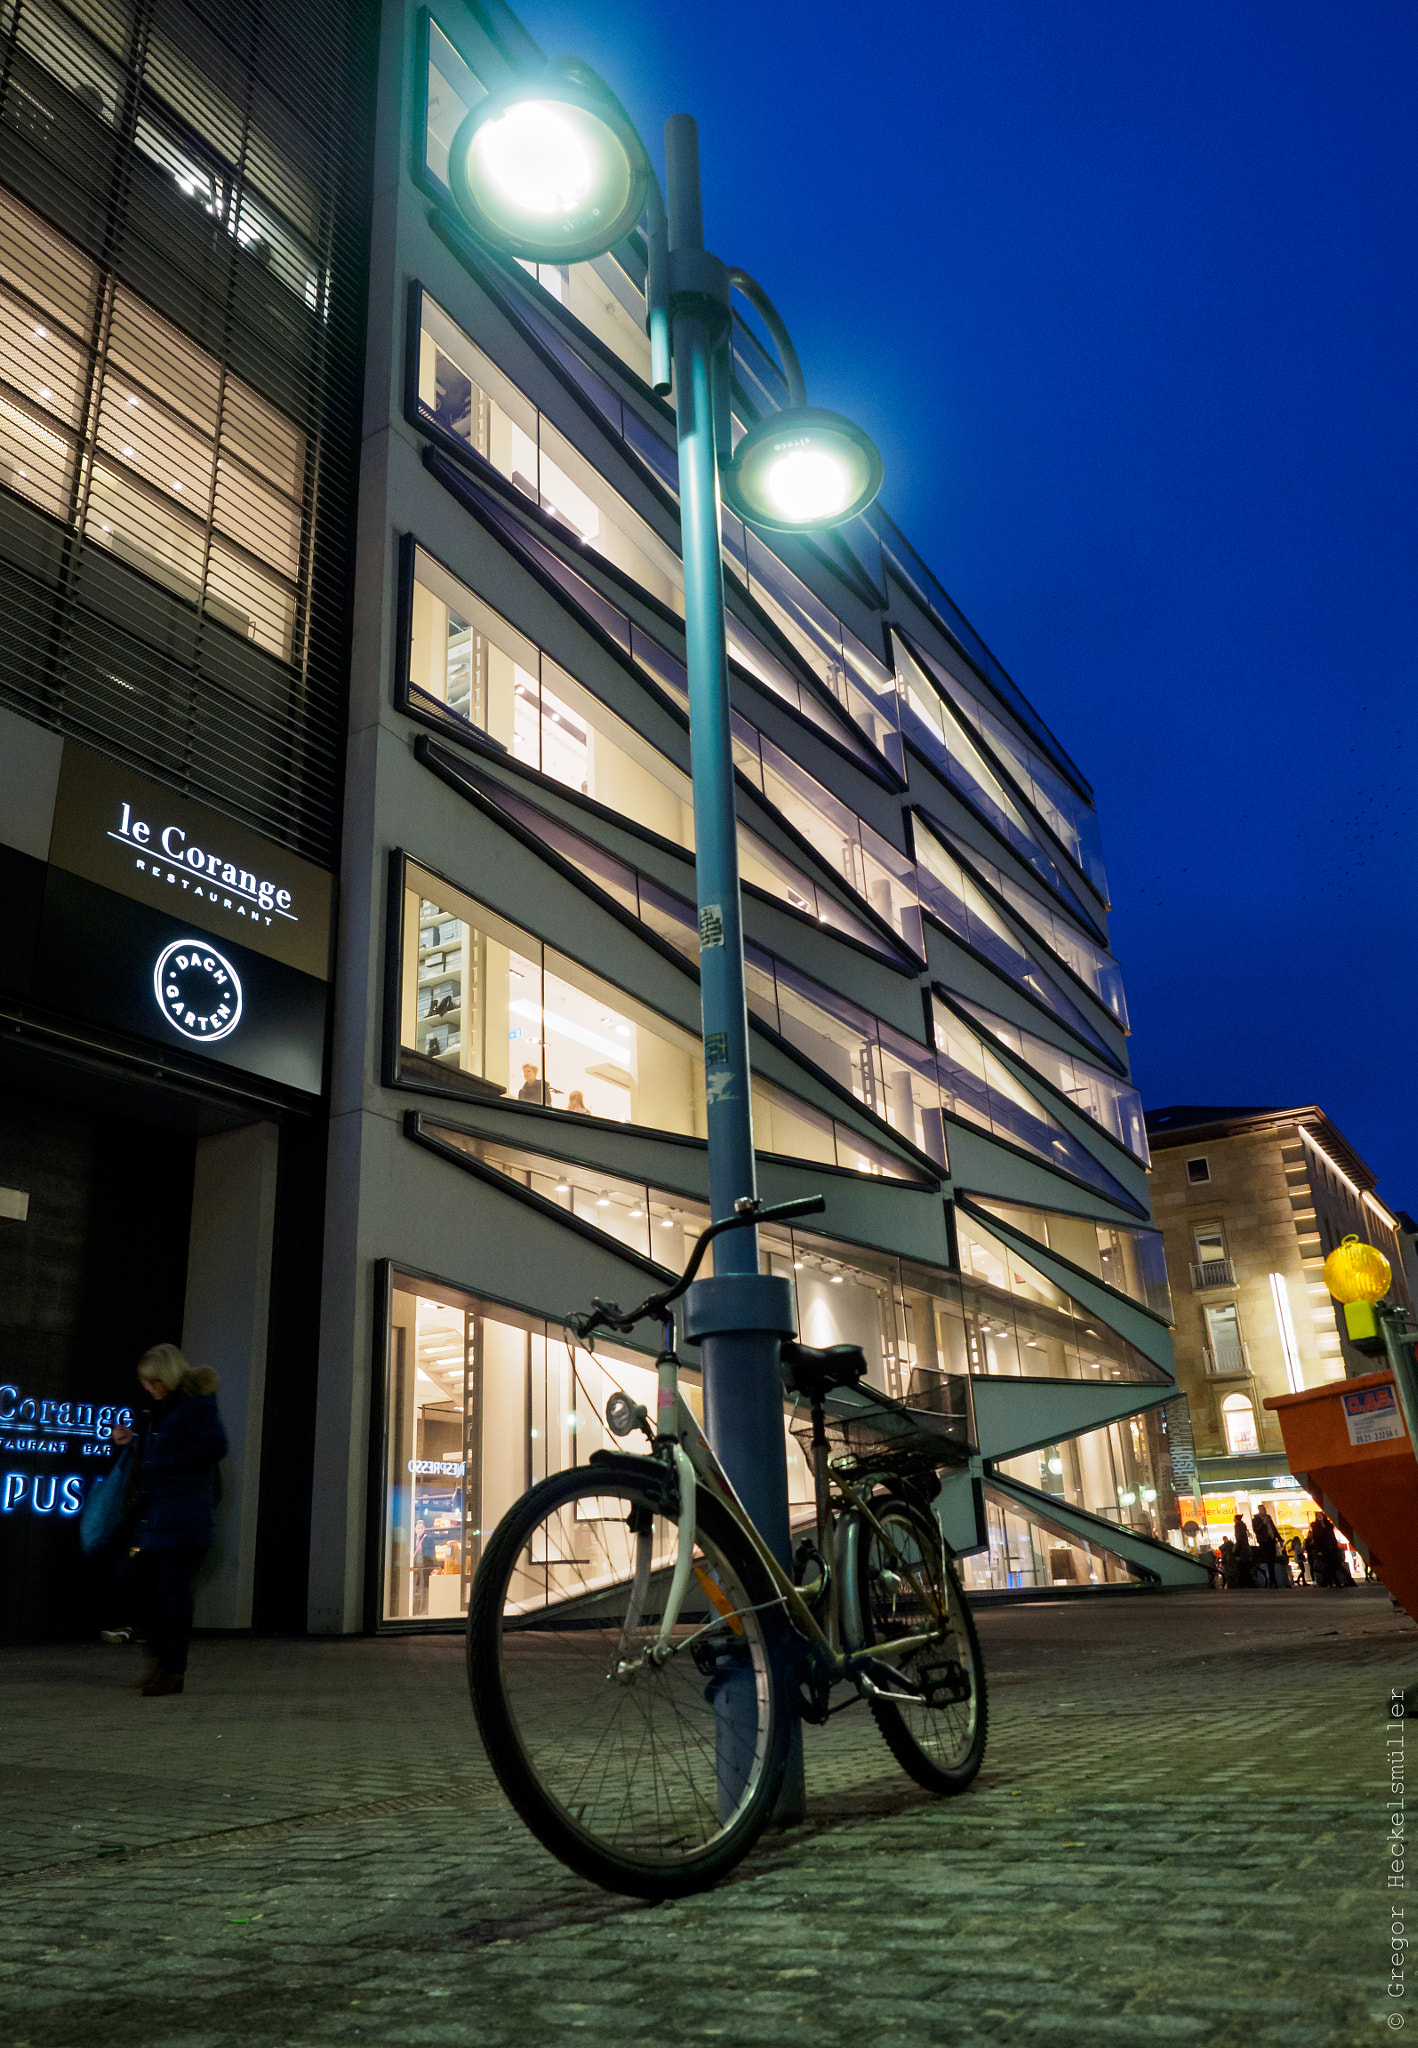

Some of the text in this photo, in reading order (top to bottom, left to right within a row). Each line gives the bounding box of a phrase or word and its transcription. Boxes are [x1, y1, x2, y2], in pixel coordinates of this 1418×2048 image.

[118, 802, 292, 911] le Corange
[136, 859, 272, 926] RESTAURANT
[175, 952, 228, 986] DACH
[166, 984, 232, 1031] GARTEN
[0, 1384, 135, 1439] Corange
[83, 1443, 113, 1455] BAR
[3, 1473, 86, 1513] PUS
